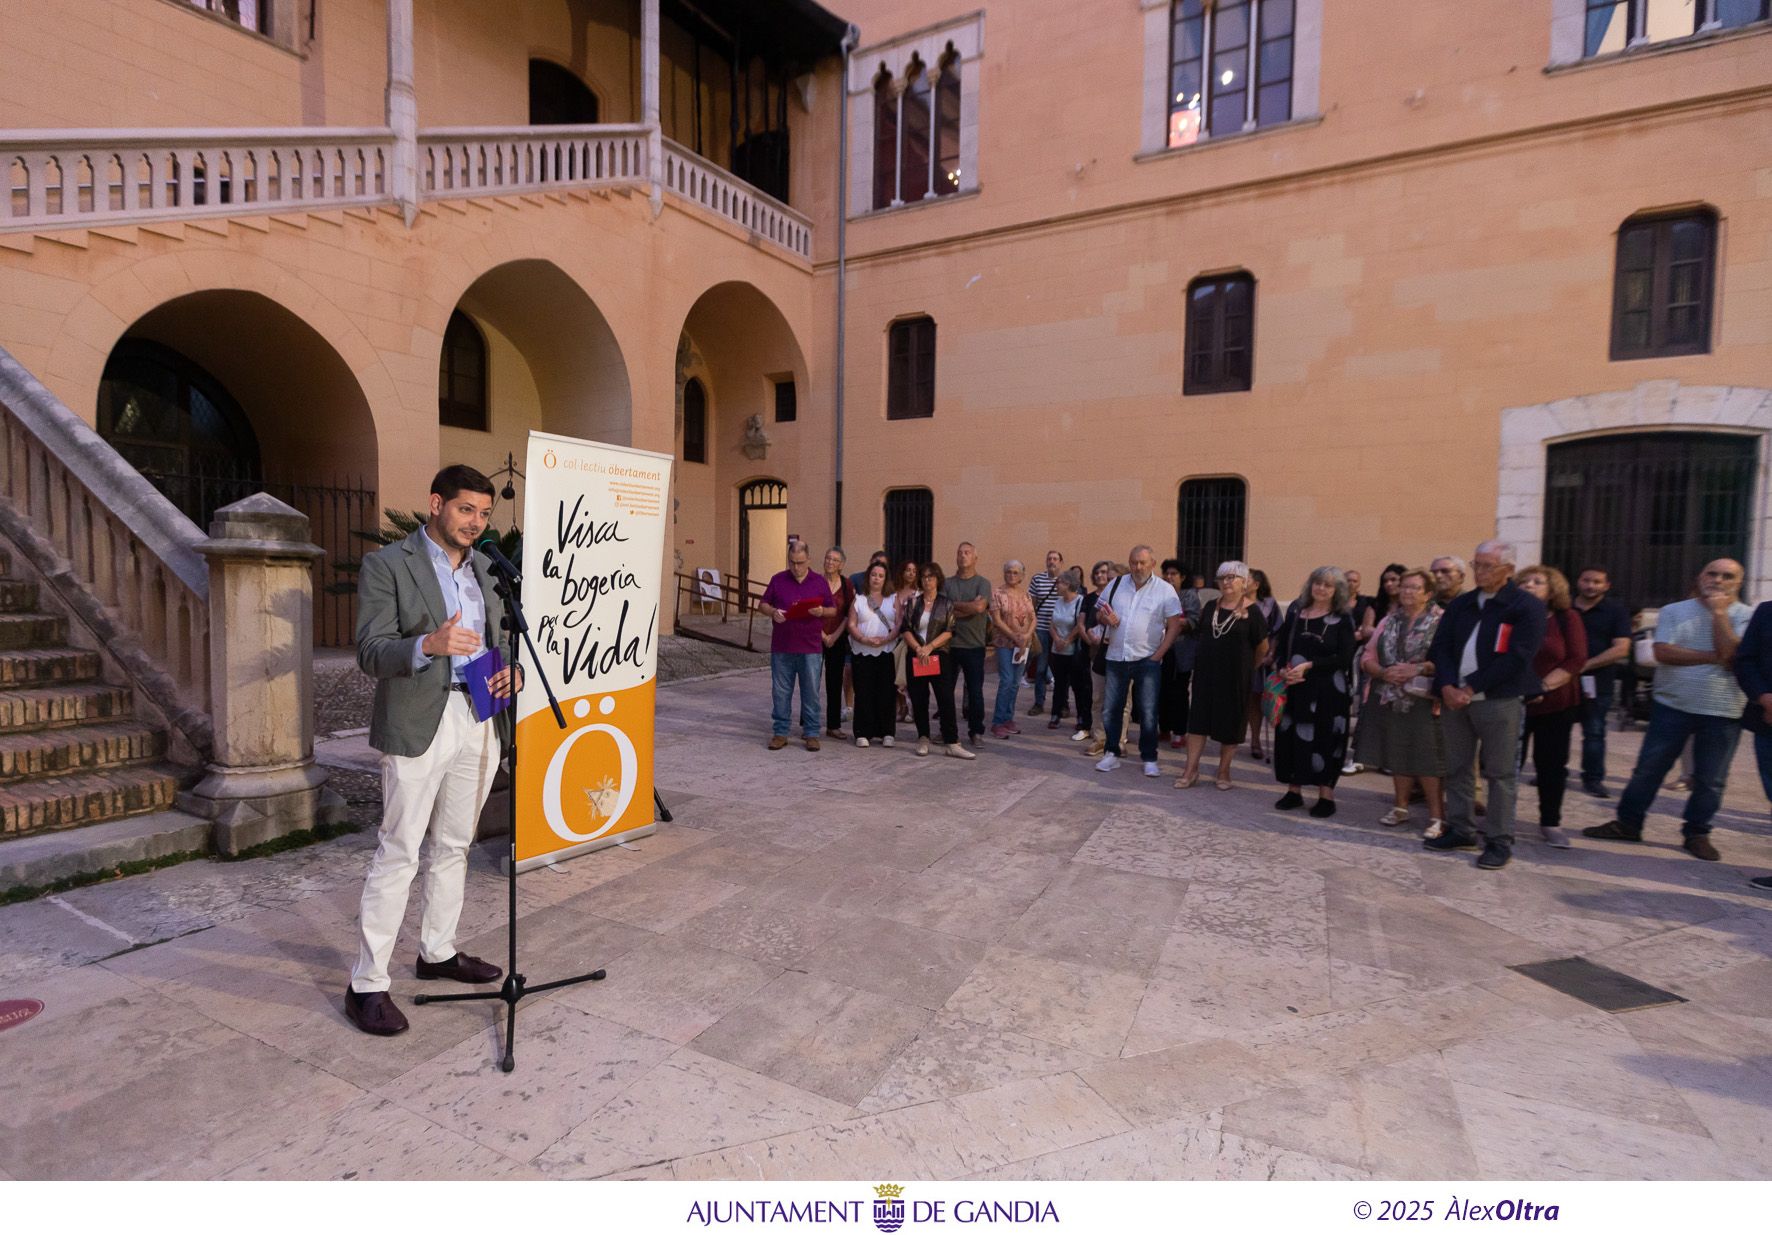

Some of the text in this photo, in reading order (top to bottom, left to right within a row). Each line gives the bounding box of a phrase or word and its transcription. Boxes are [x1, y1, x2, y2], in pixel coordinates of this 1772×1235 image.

[608, 464, 661, 481] öbertament
[557, 493, 630, 554] Visca
[542, 548, 642, 628] la bogeria
[537, 614, 560, 643] per
[546, 599, 658, 685] la Vida!
